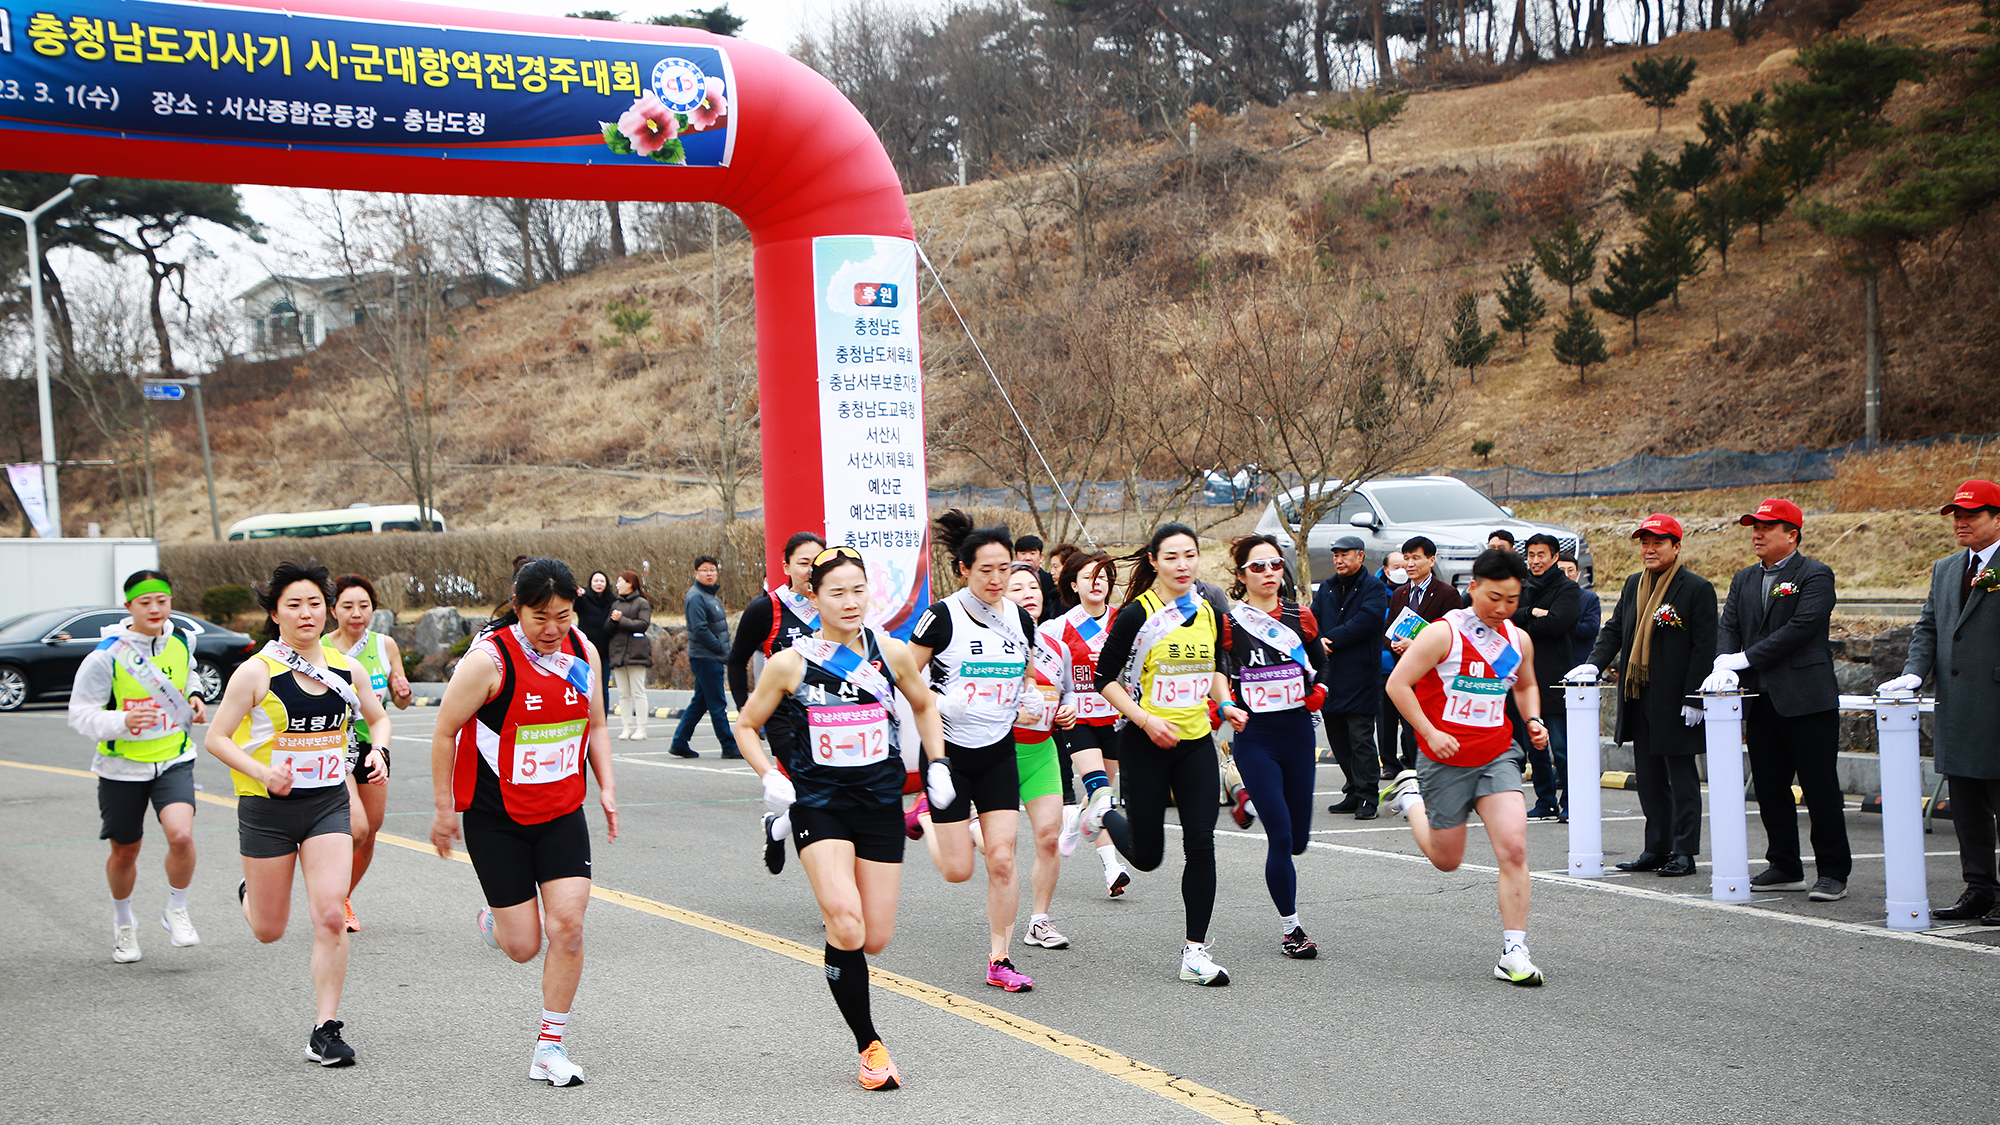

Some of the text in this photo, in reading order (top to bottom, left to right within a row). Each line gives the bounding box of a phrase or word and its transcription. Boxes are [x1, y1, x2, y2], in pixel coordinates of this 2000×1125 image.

[28, 12, 292, 76] 충청남도지사기
[305, 40, 642, 97] 시·군대항역전경주대회
[34, 82, 54, 104] 3.
[151, 91, 198, 115] 장소
[220, 97, 377, 129] 서산종합운동장
[403, 109, 486, 136] 충남도청
[862, 286, 893, 304] 후원
[854, 317, 900, 336] 충청남도
[835, 345, 913, 364] 충청남도체육회
[829, 373, 917, 393] 충남서부보훈지청
[838, 401, 915, 419] 충청남도교육청
[866, 426, 901, 444] 서산시
[847, 452, 914, 469] 서산시체육회
[868, 478, 902, 495] 예산군
[850, 503, 916, 520] 예산군체육회
[844, 530, 920, 548] 충남지방경찰청
[524, 686, 579, 711] 논산
[806, 682, 860, 705] 서산
[1156, 678, 1210, 702] 13-12
[1245, 683, 1304, 707] 12-12
[1450, 695, 1504, 722] 14-12
[288, 712, 346, 732] 보령시
[278, 735, 342, 747] 충남서부보훈지청
[819, 728, 884, 759] 8-12
[520, 743, 576, 777] 5-12
